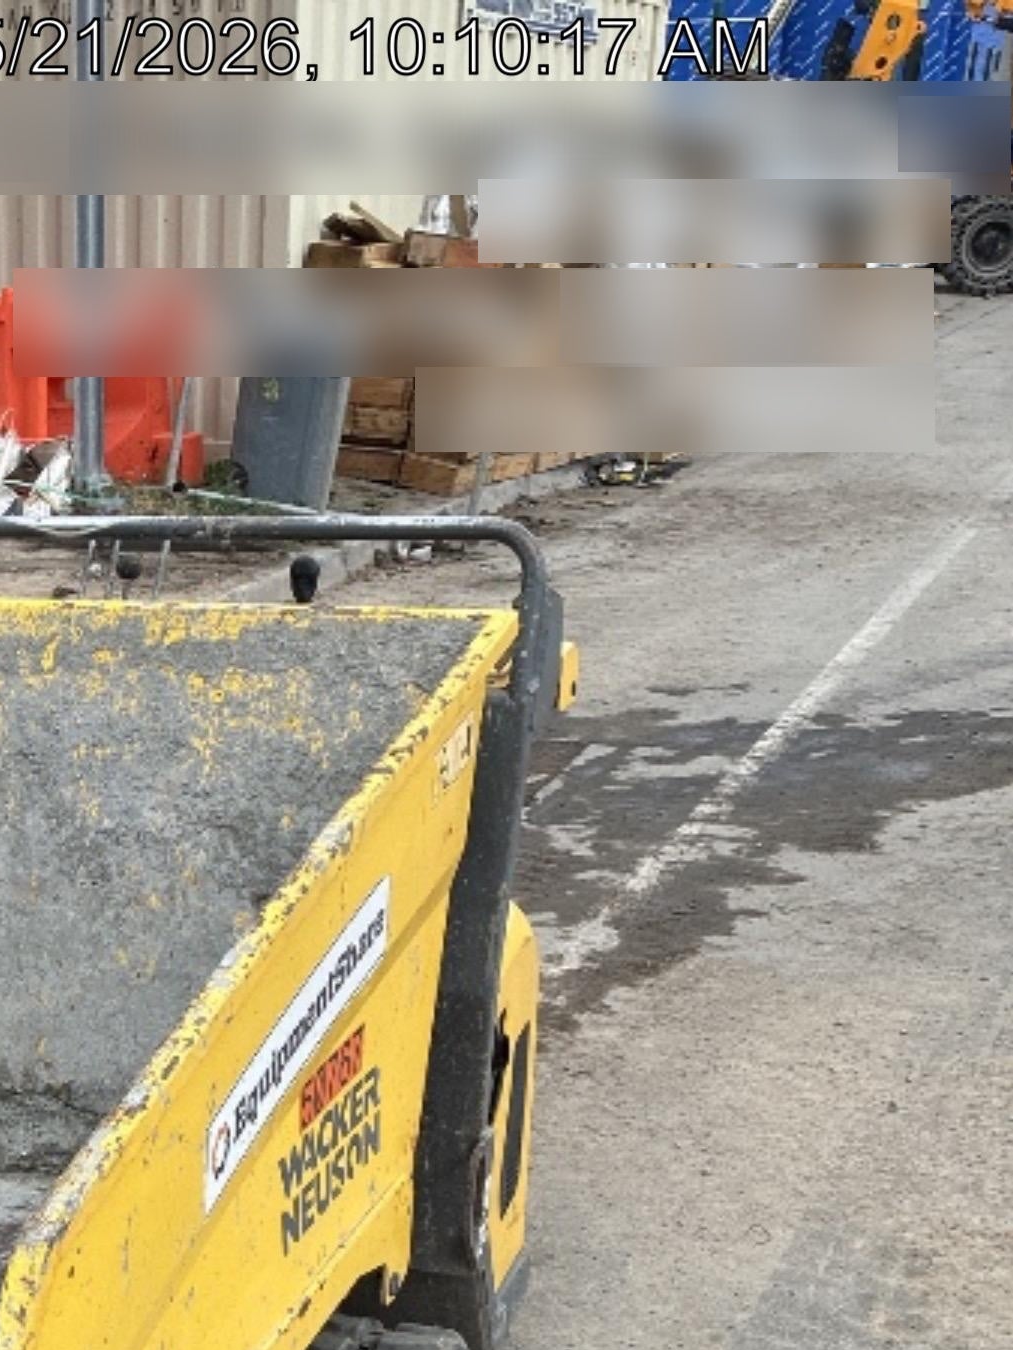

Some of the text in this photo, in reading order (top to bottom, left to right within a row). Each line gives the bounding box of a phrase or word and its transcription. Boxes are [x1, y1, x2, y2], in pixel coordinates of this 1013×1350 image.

[232, 908, 386, 1143] EquipmentShare
[277, 1064, 381, 1198] WACKER
[280, 1109, 381, 1257] NEUSON
